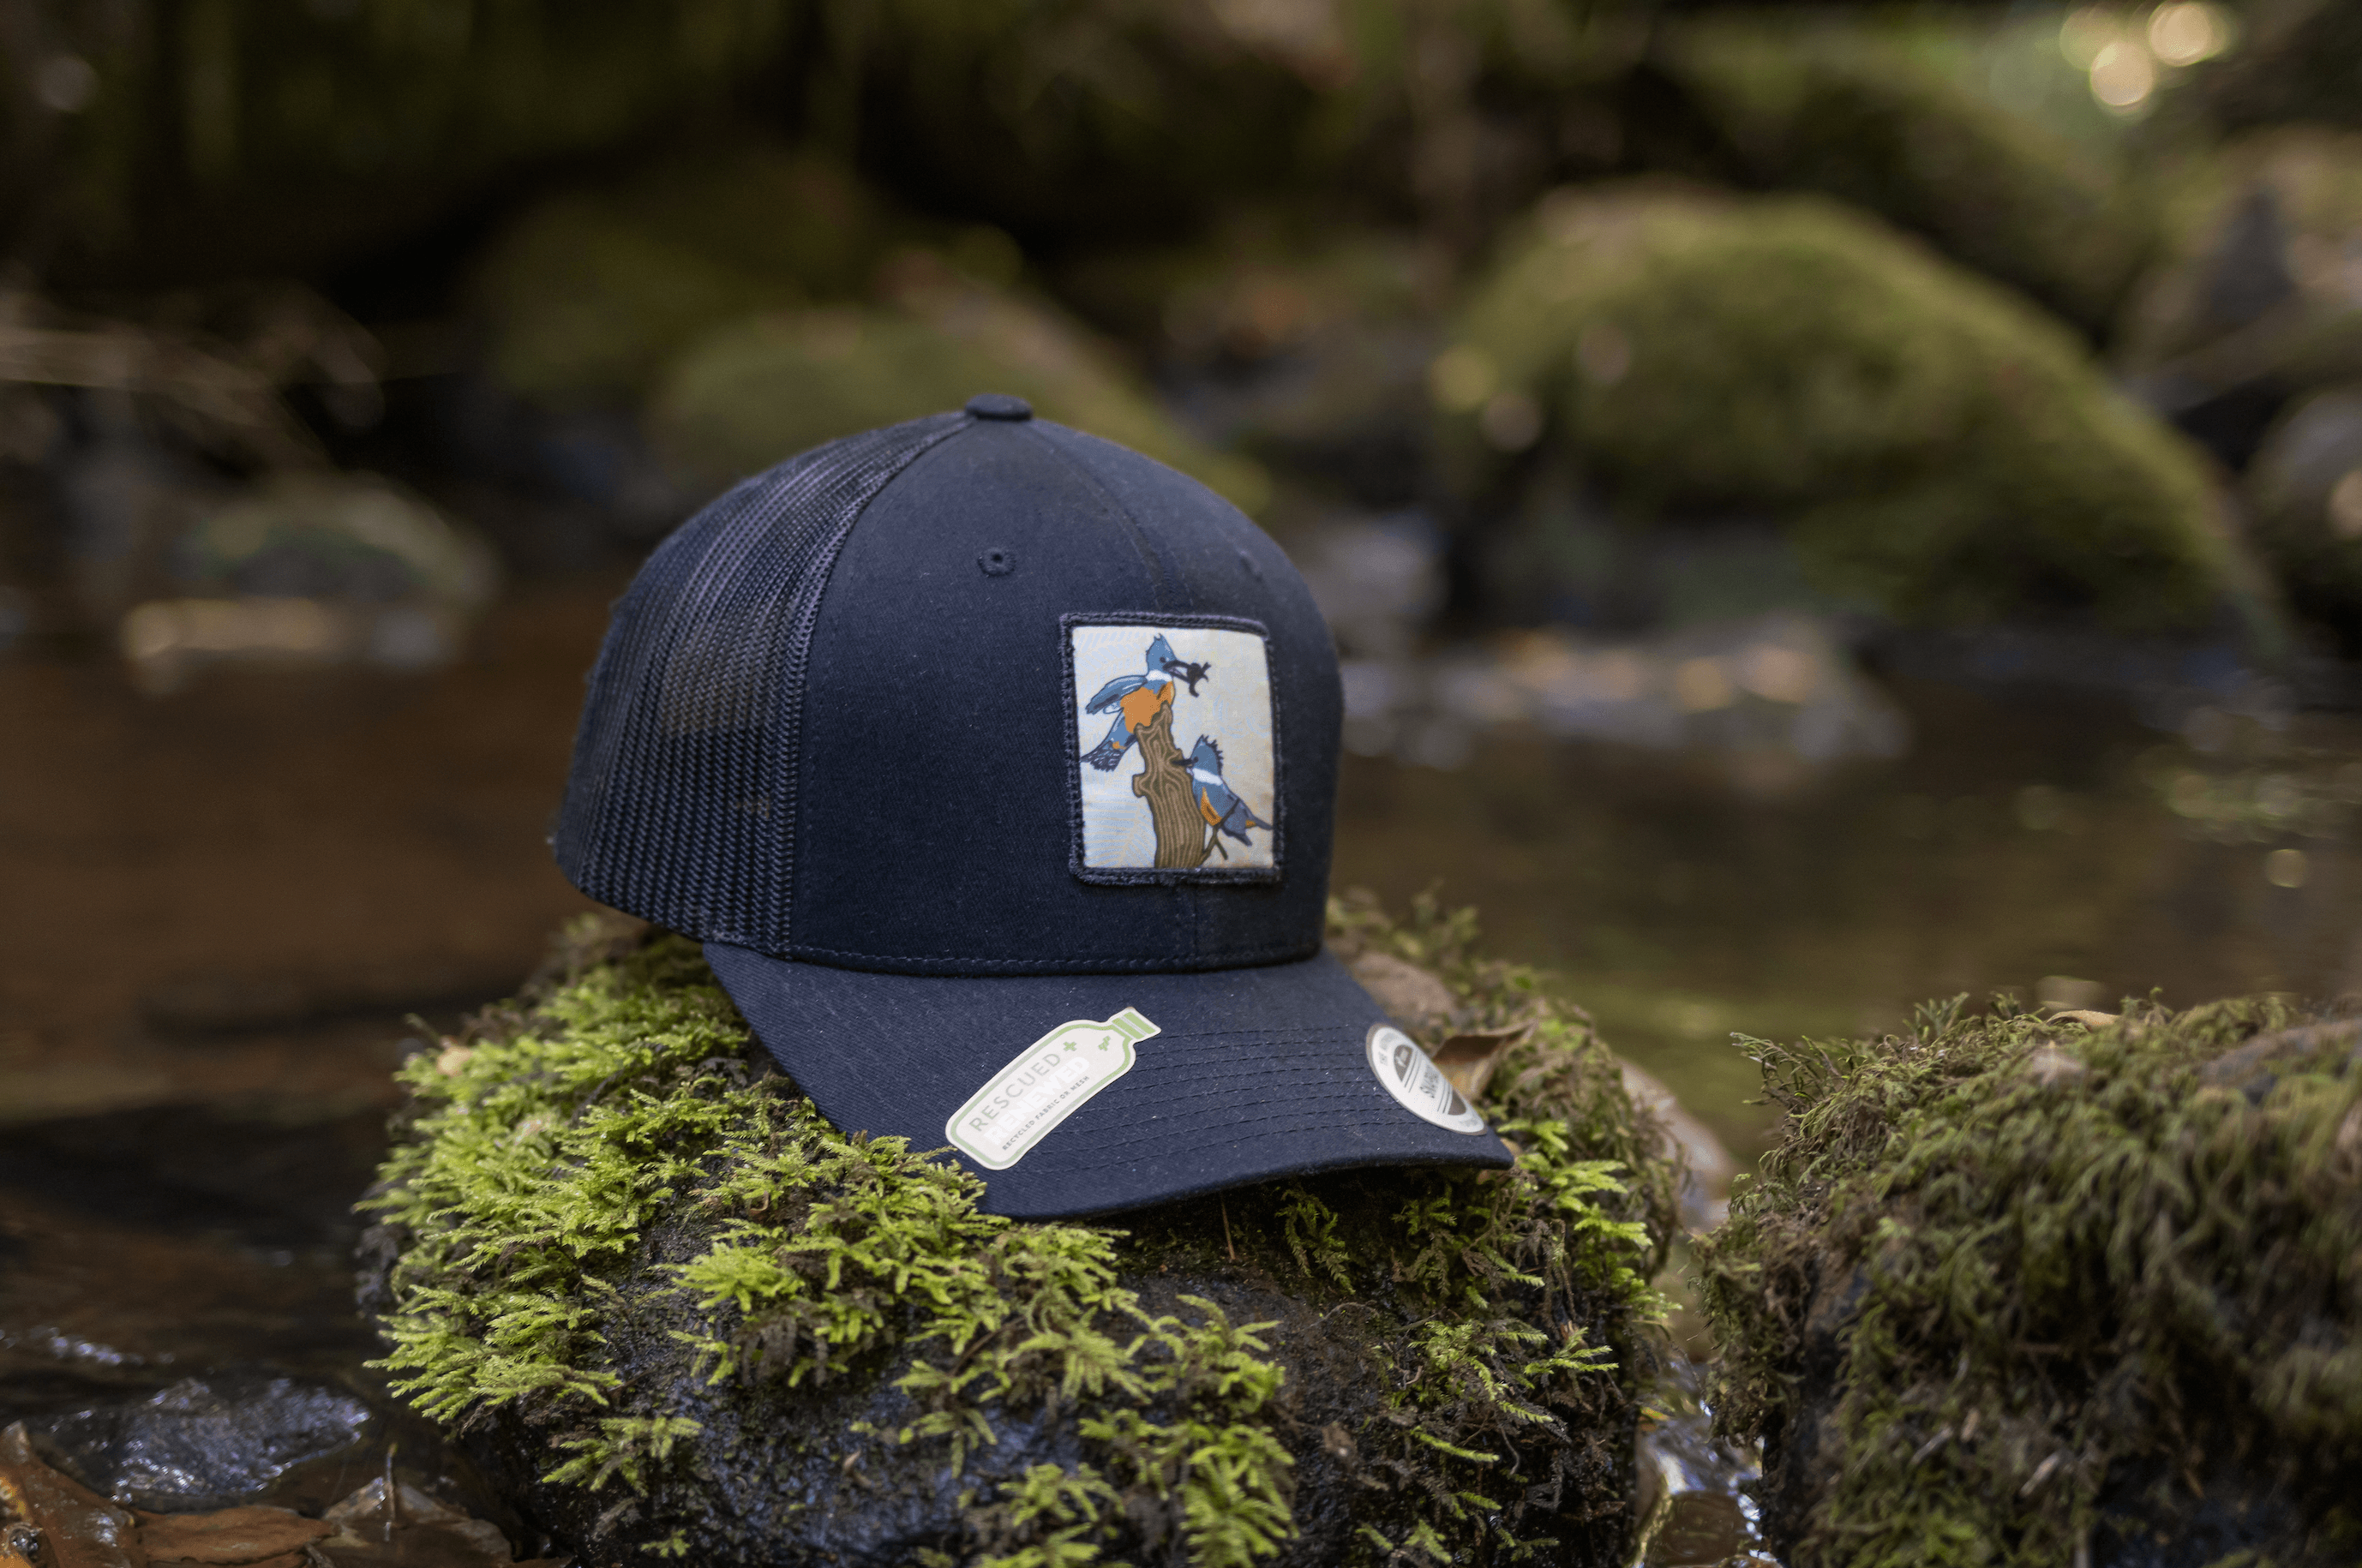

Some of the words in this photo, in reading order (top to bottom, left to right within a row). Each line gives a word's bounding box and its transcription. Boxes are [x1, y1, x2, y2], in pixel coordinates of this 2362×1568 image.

[968, 1052, 1061, 1132] RESCUED
[984, 1056, 1090, 1146] RENEWED
[1002, 1119, 1035, 1151] RECYCLED
[1034, 1098, 1060, 1121] FABRIC
[1059, 1090, 1070, 1100] OR
[1070, 1075, 1090, 1092] MESH
